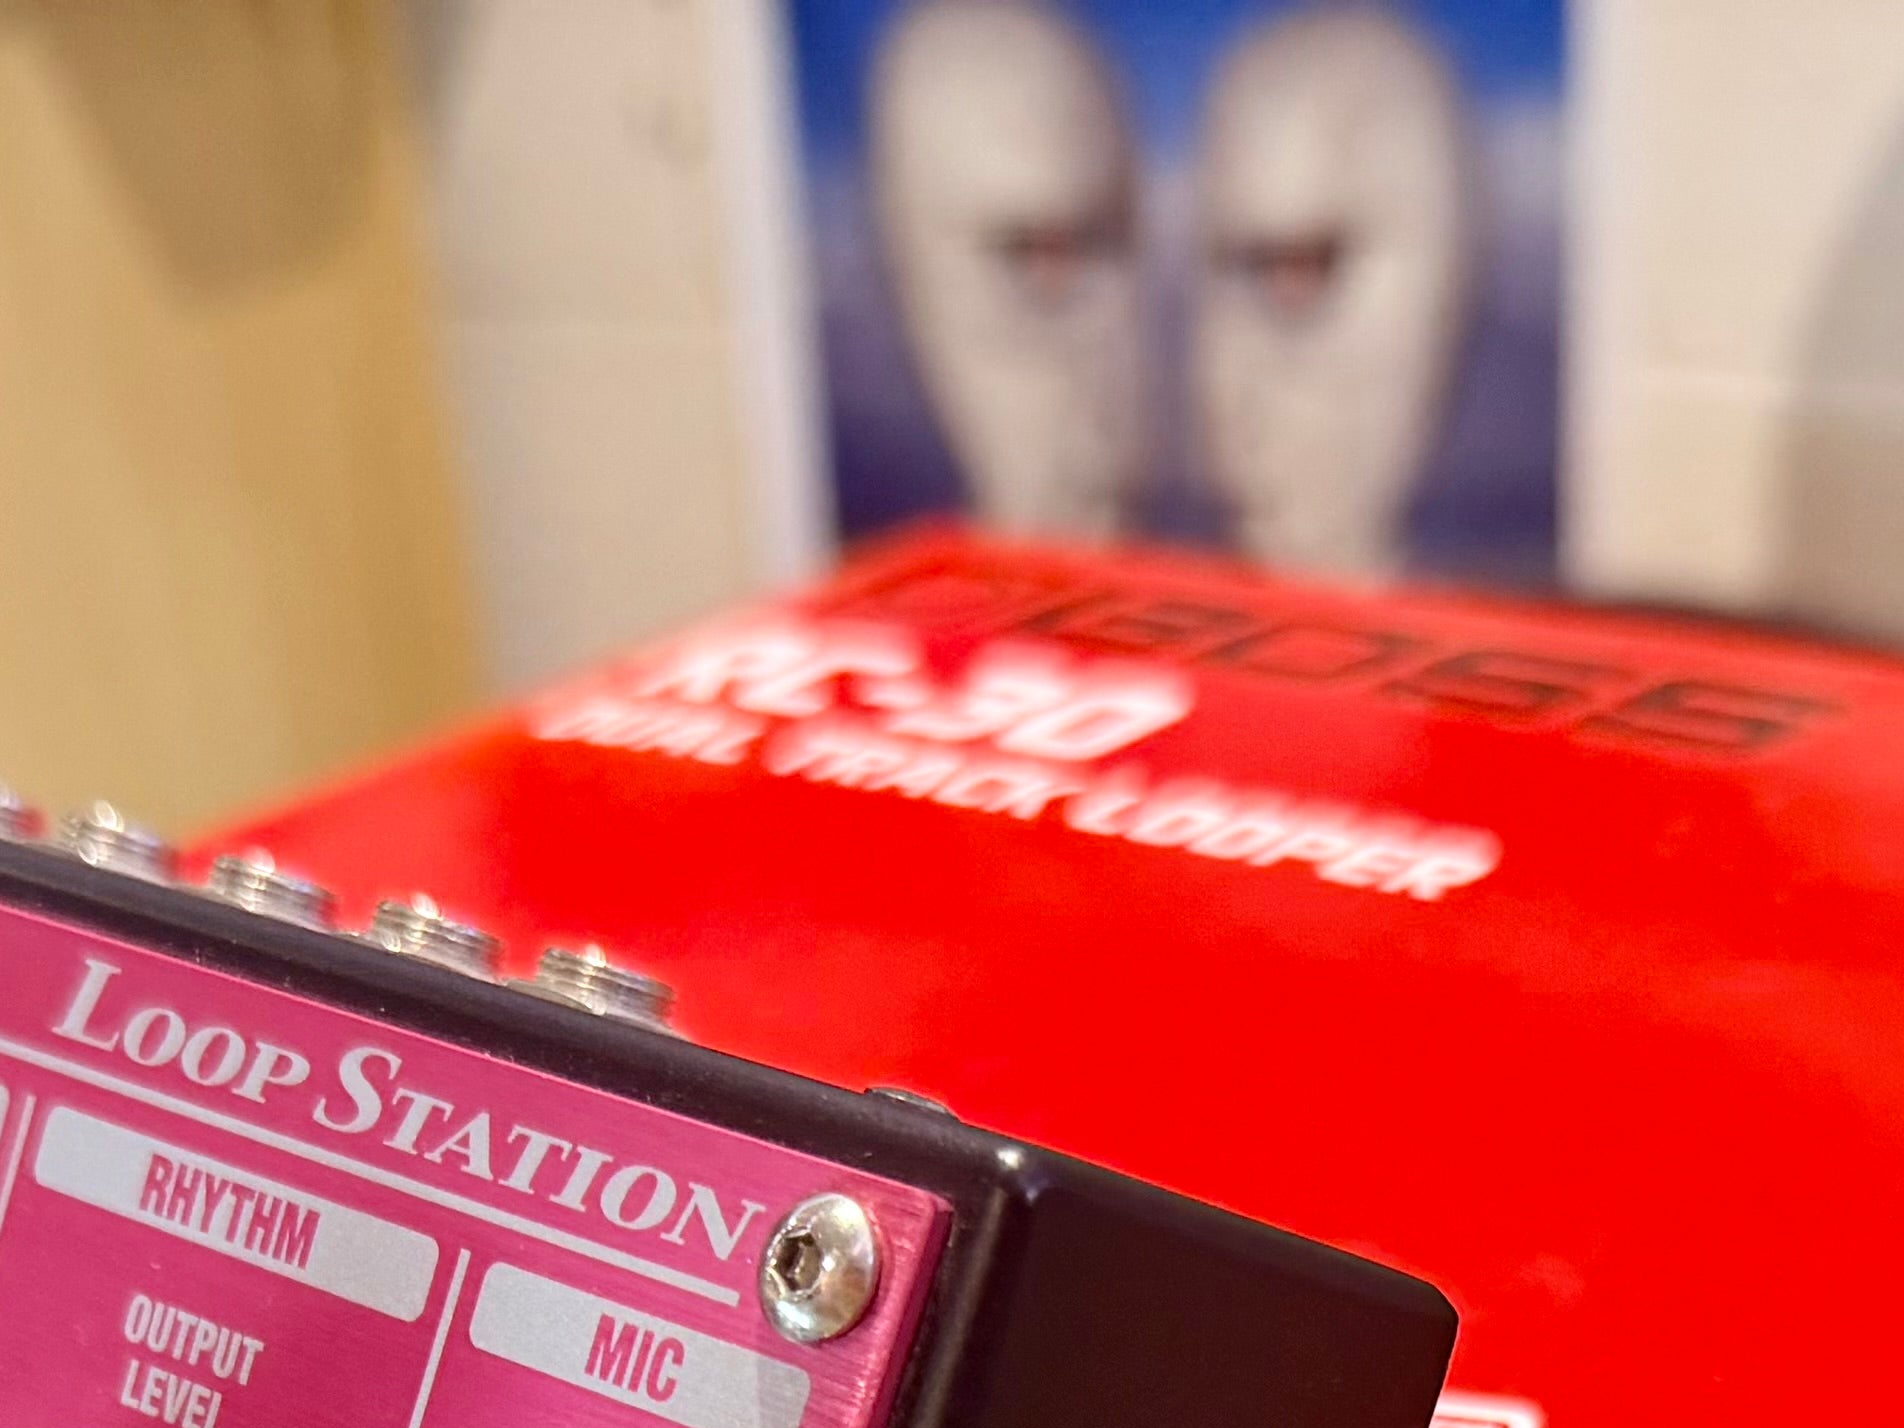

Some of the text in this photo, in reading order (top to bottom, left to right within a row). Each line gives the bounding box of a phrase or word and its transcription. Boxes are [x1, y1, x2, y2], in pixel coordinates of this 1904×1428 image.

[641, 622, 1195, 761] RC-30
[764, 724, 1086, 819] TRACK
[1064, 765, 1504, 903] LOOPER
[52, 956, 766, 1264] LOOP STATION
[139, 1153, 320, 1271] RHYTHM
[123, 1294, 264, 1385] OUTPUT
[584, 1312, 685, 1402] MIC
